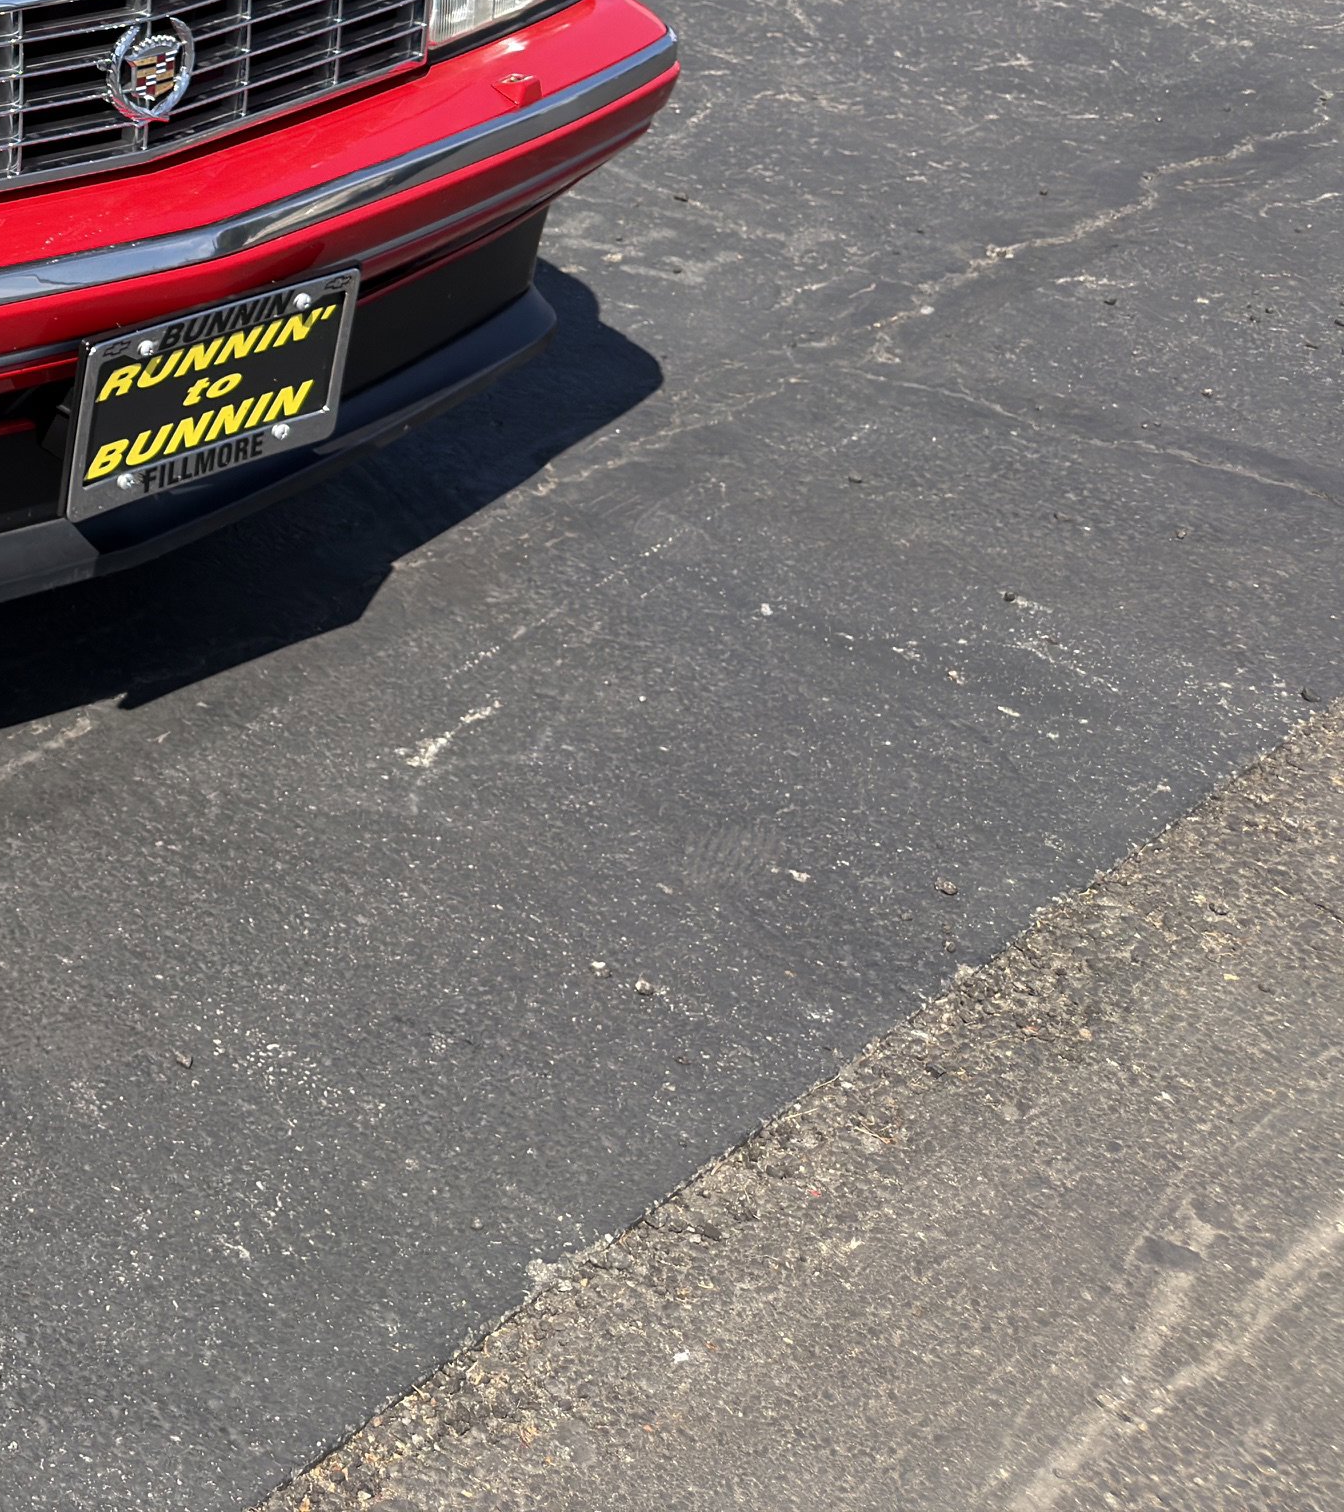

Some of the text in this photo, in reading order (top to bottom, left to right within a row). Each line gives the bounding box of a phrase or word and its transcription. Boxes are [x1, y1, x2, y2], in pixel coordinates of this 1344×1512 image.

[158, 289, 296, 350] BUNNIN
[95, 303, 337, 403] RUNNIN'
[182, 372, 243, 407] to
[83, 379, 315, 482] BUNNIN
[142, 431, 266, 494] FILLMORE
